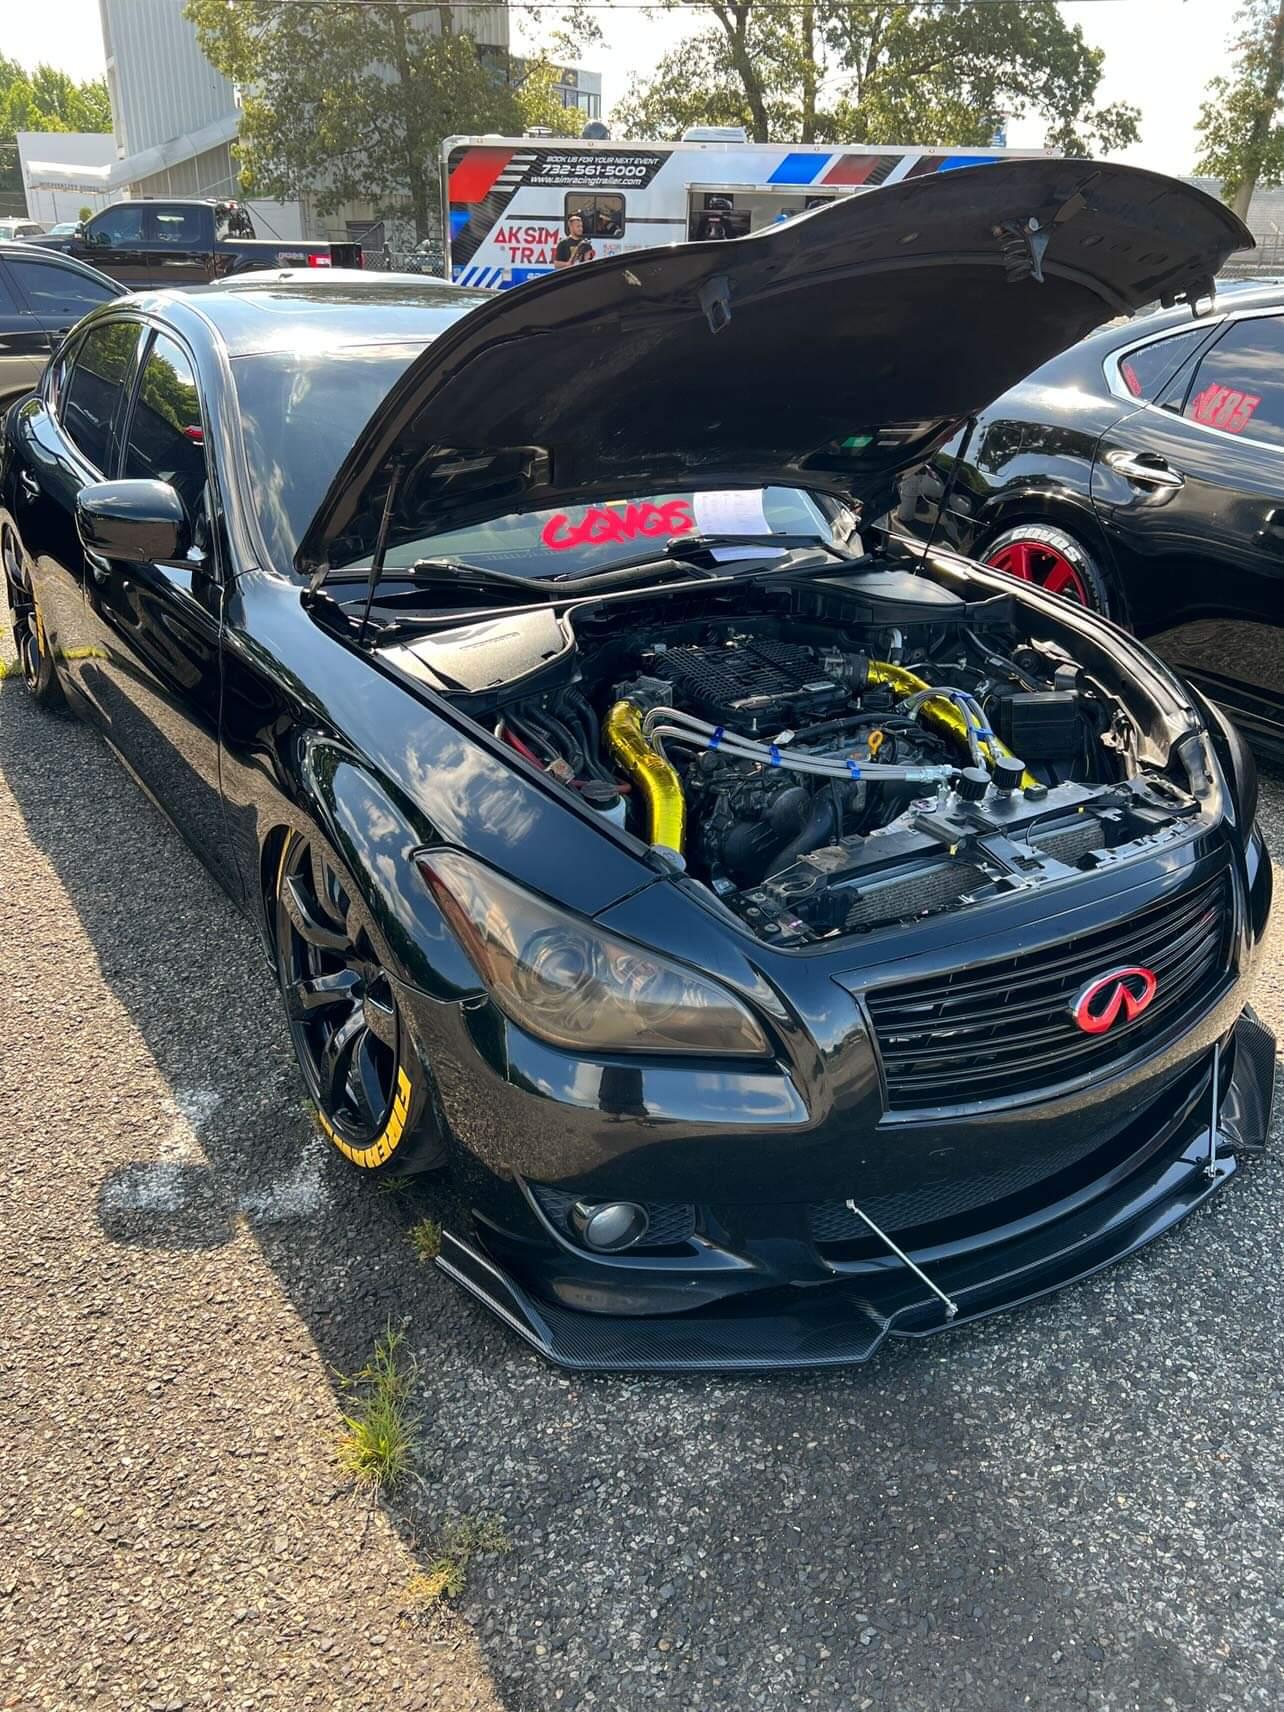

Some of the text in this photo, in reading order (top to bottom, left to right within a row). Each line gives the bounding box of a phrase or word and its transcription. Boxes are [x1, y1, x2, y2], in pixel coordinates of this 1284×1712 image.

[546, 155, 566, 163] BOOK
[578, 156, 594, 164] FOR
[594, 156, 615, 164] YOUR
[634, 157, 659, 165] EVENT
[541, 164, 646, 176] 732-561-5000
[530, 176, 642, 186] www.simracingtrailer.com
